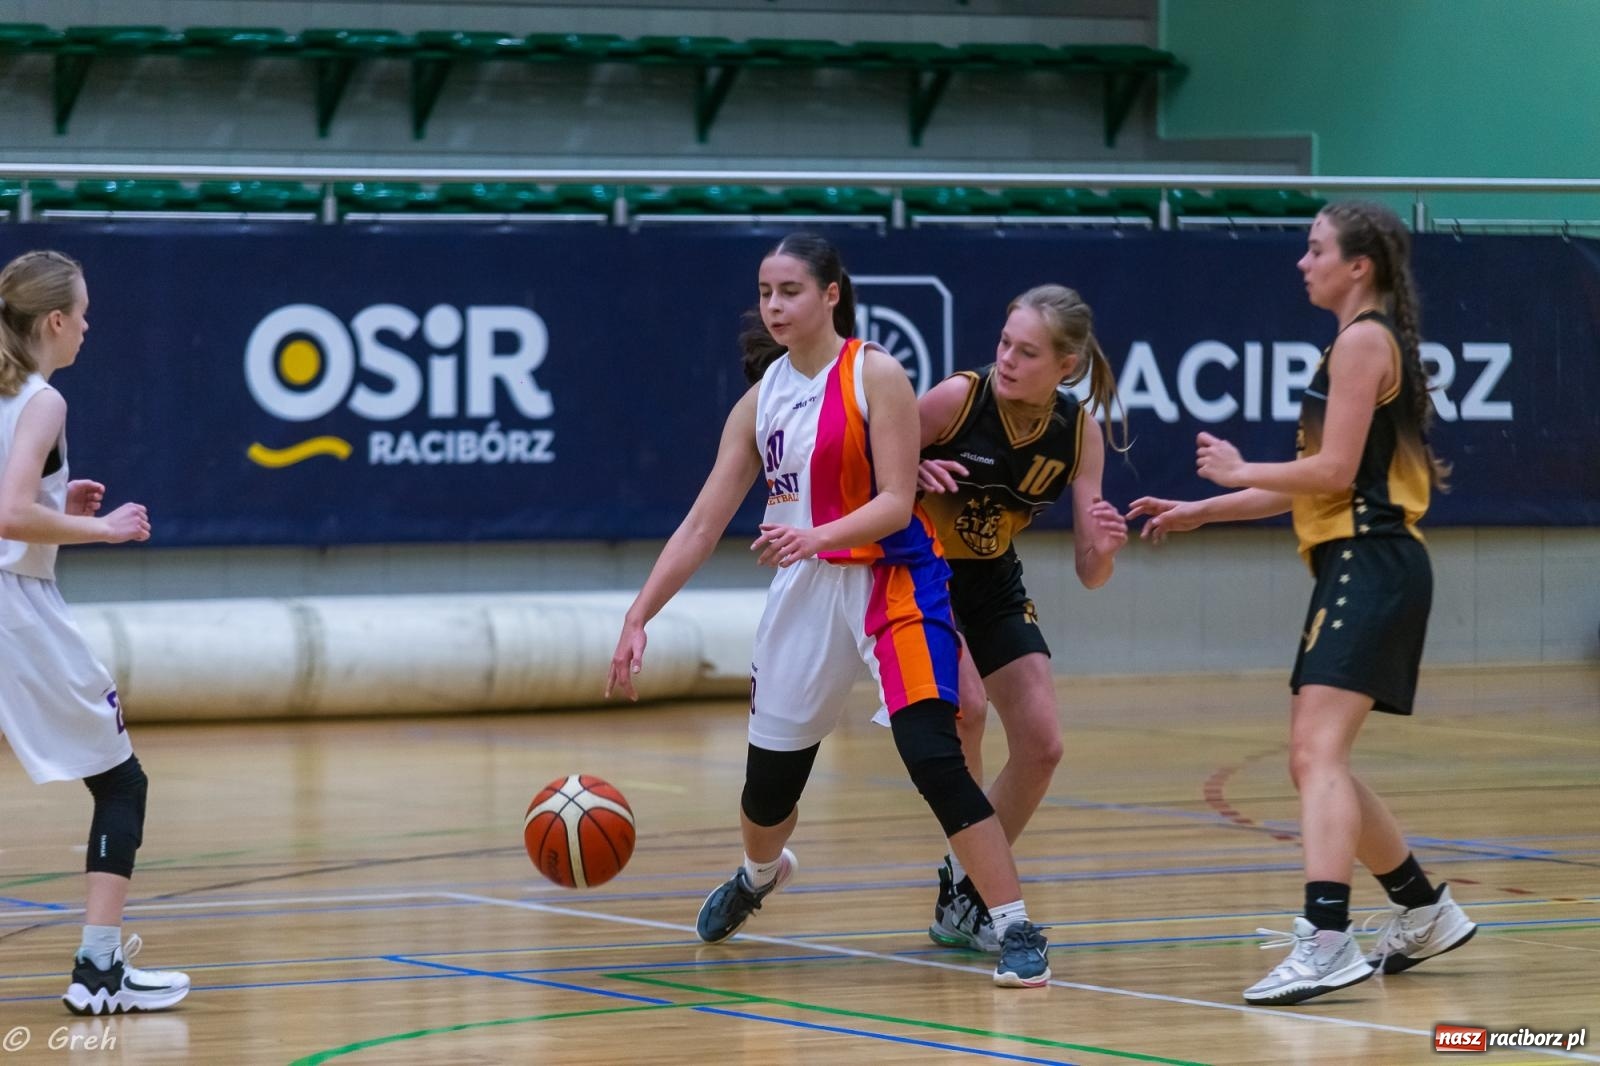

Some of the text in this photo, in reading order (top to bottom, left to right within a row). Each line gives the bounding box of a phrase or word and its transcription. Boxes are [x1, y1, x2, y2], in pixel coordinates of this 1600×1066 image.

[1056, 340, 1513, 422] ACIBRZ
[368, 421, 555, 465] RACIBÓRZ
[1017, 454, 1066, 496] 10
